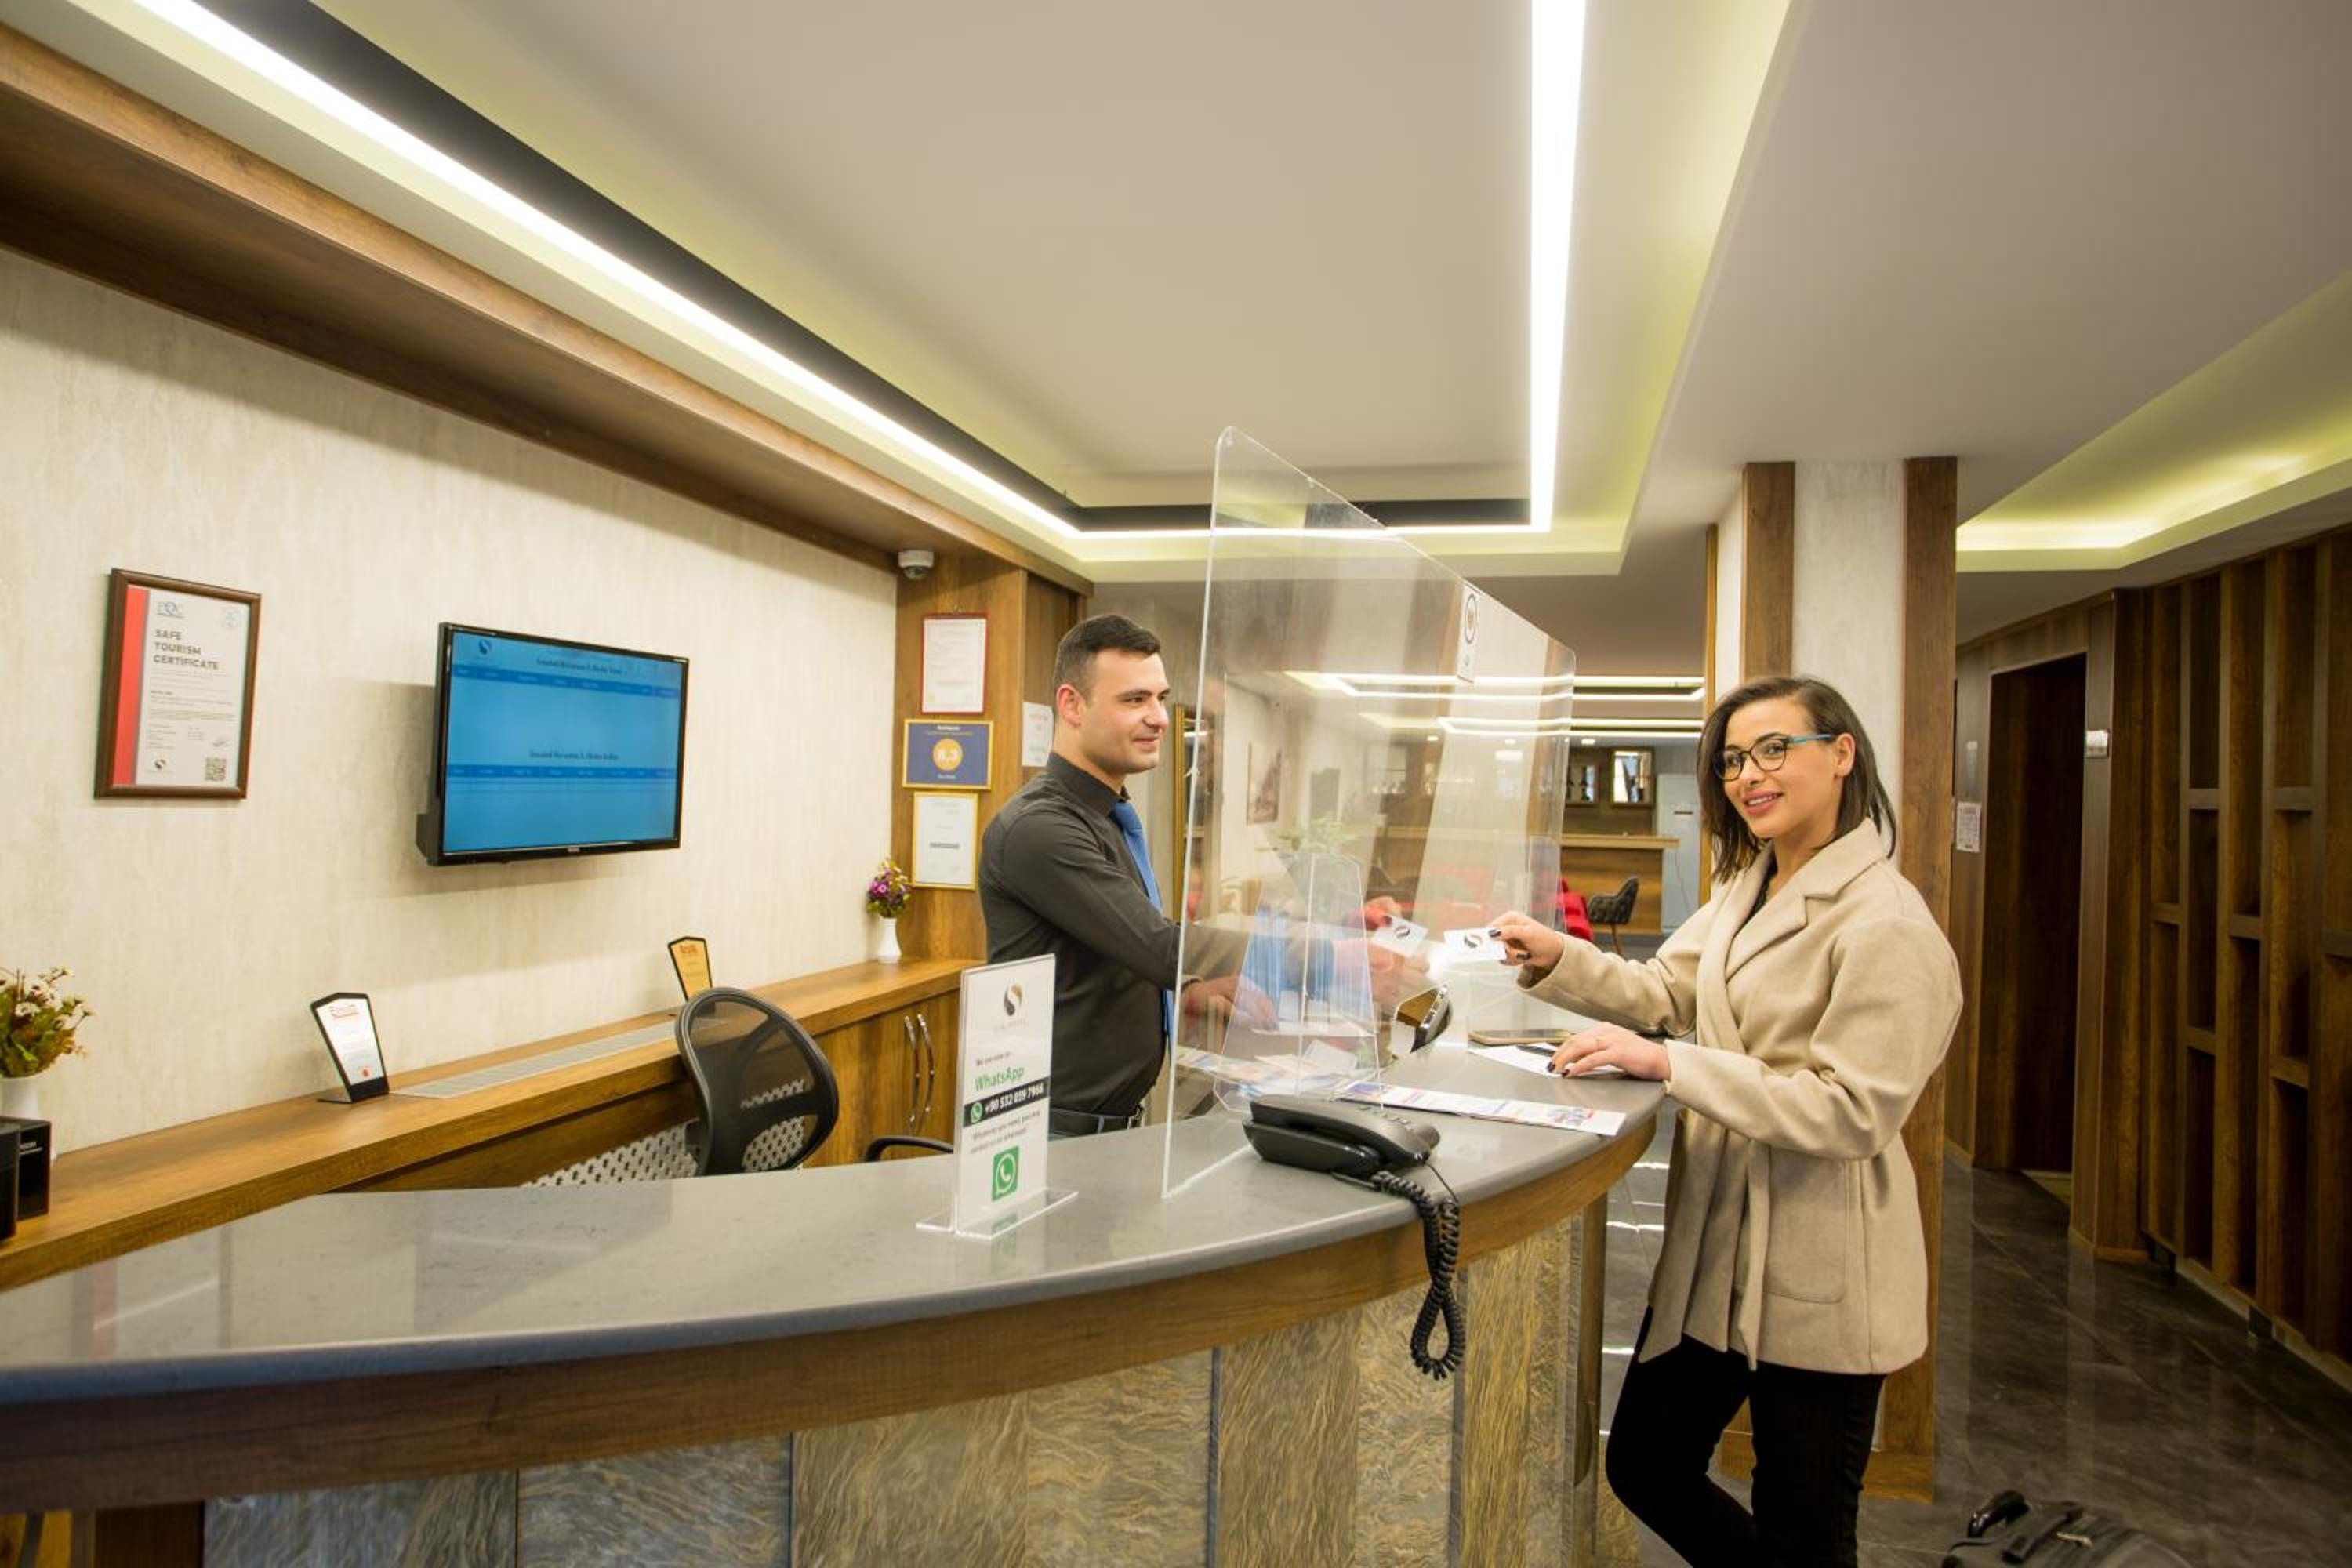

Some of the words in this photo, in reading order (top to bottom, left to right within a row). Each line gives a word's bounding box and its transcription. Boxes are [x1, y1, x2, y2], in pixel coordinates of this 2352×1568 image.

[154, 629, 182, 641] SAFE
[154, 641, 201, 655] TOURISM
[153, 655, 220, 670] CERTIFICATE
[975, 1066, 1025, 1091] WhatsApp
